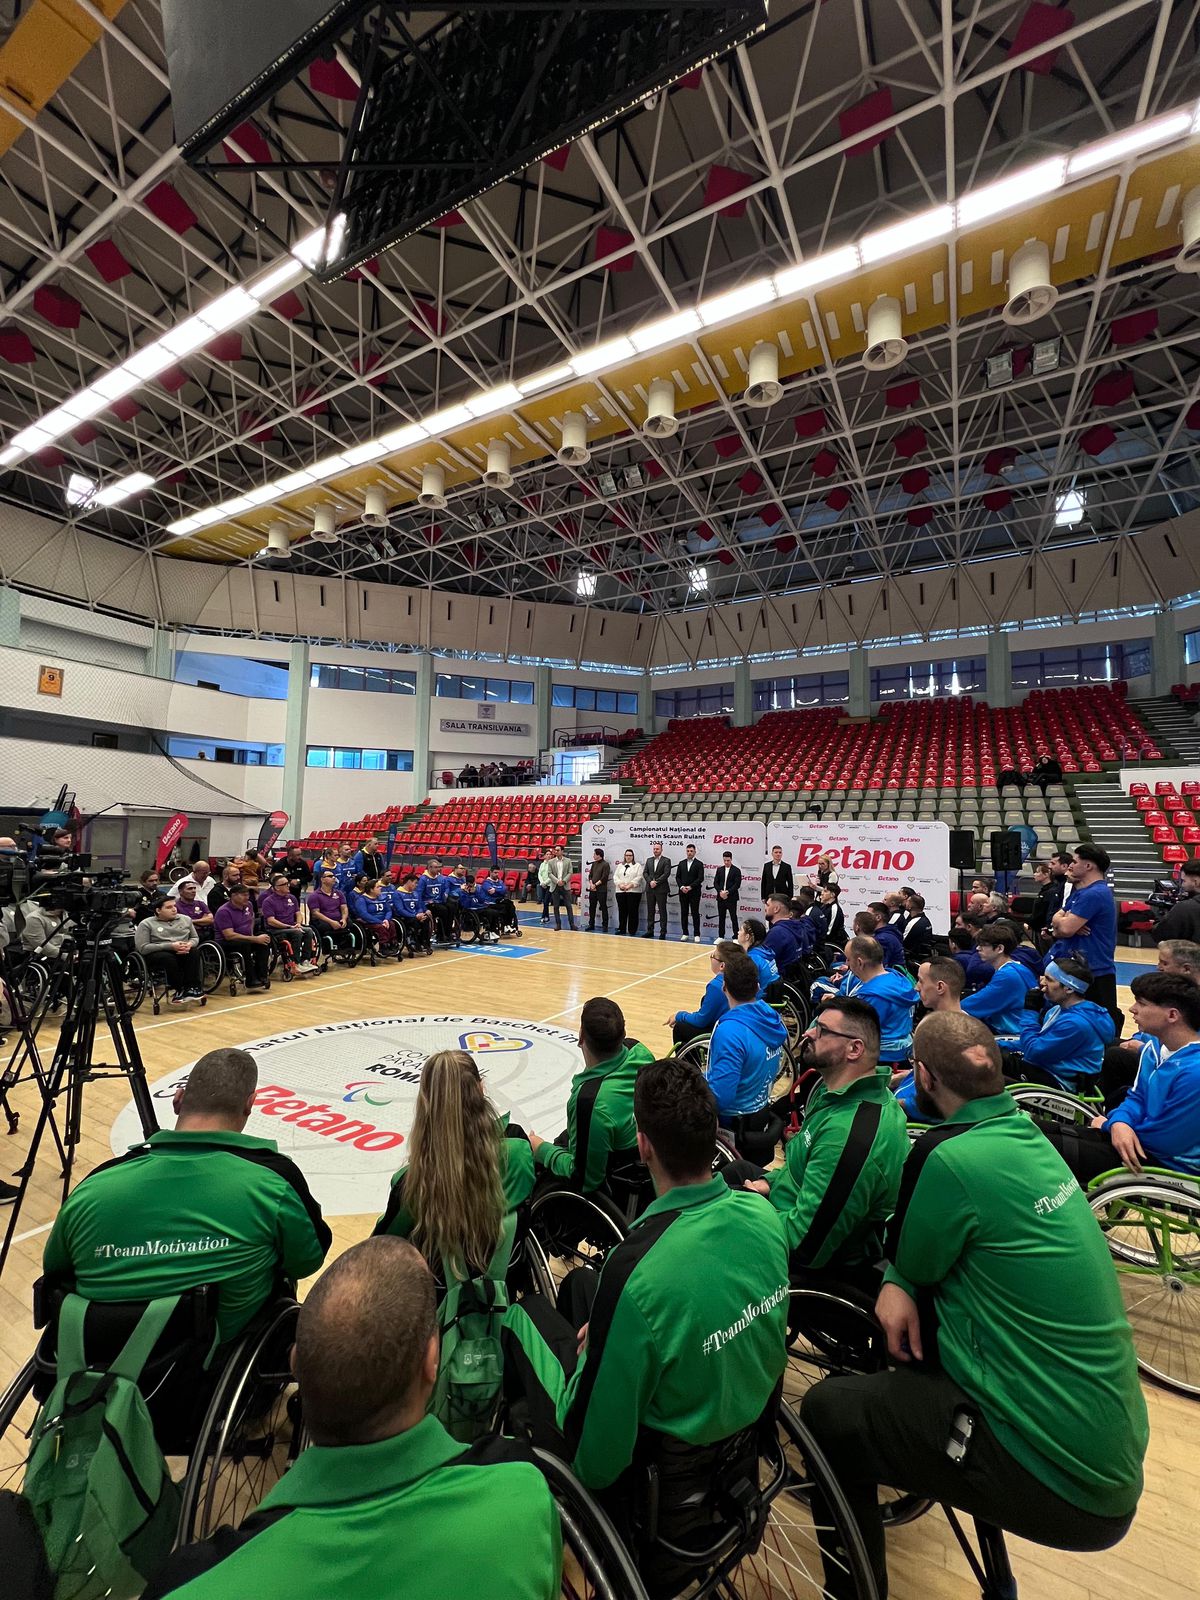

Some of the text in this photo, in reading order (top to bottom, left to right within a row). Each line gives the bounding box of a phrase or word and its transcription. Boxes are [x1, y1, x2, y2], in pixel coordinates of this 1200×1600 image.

[445, 721, 522, 733] SALA TRANSILVANIA
[162, 818, 181, 845] Betano
[713, 834, 754, 845] Betano
[797, 843, 915, 871] Betano
[314, 1017, 425, 1034] Național
[470, 1017, 559, 1036] Baschet
[253, 1085, 405, 1152] Betano
[94, 1236, 230, 1258] #TeamMotivation
